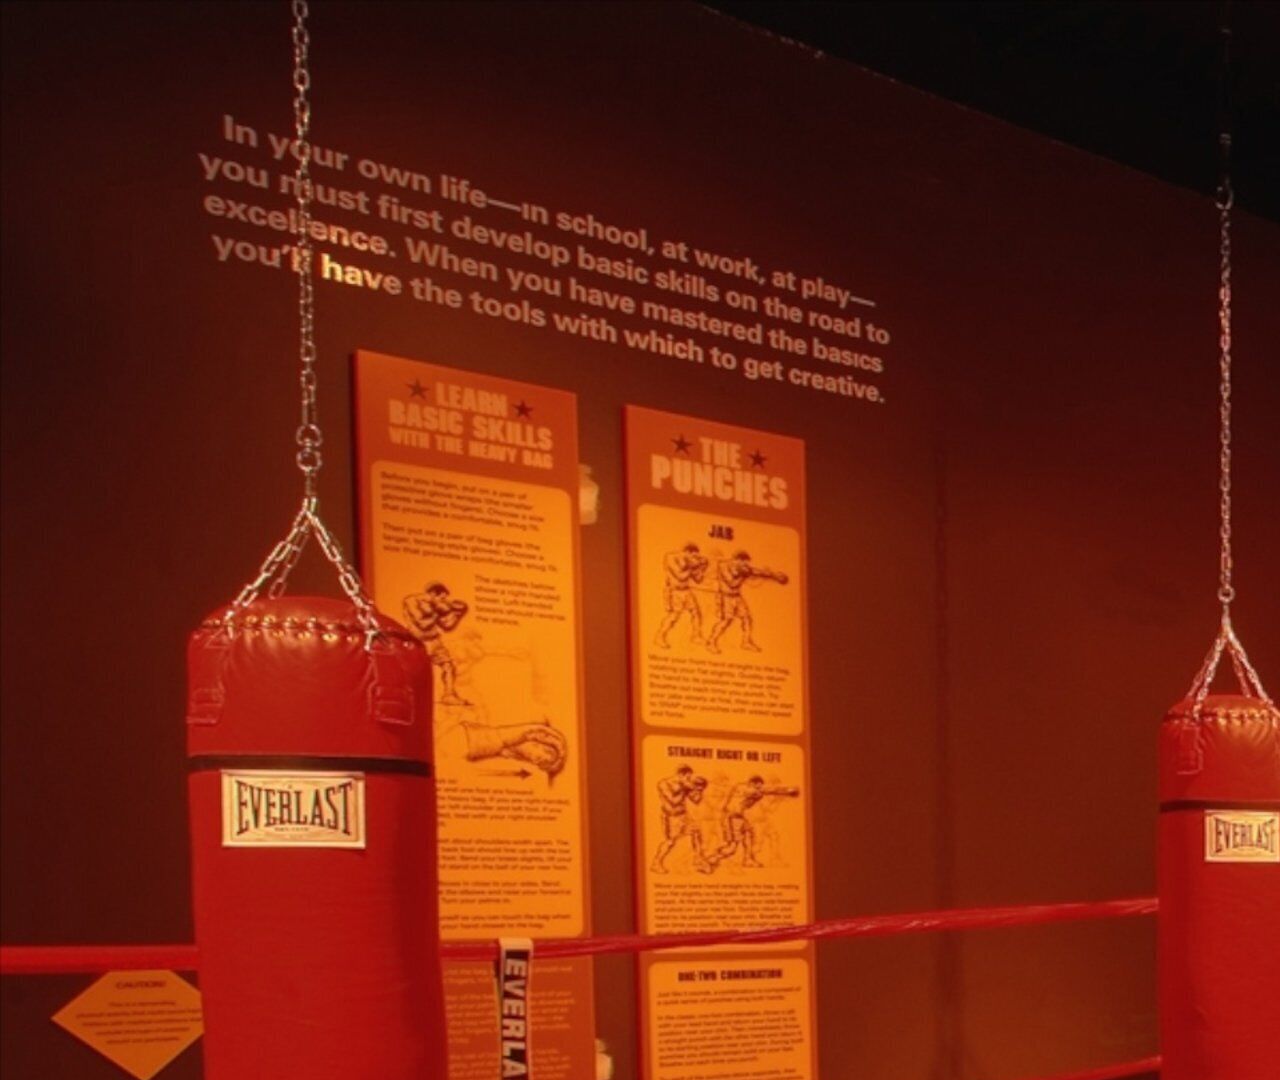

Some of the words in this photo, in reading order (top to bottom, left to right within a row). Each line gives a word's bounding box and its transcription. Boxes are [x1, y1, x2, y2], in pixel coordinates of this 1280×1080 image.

[224, 114, 257, 148] In
[268, 136, 349, 172] your
[358, 159, 431, 194] own
[556, 212, 655, 256] school,
[662, 241, 688, 263] at
[694, 249, 766, 285] work,
[772, 271, 796, 291] at
[199, 153, 268, 189] you
[377, 195, 443, 234] first
[451, 216, 570, 267] develop
[577, 245, 649, 285] basic
[655, 269, 720, 302] skills
[726, 290, 757, 313] on
[763, 297, 803, 324] the
[809, 311, 861, 338] road
[865, 323, 890, 345] to
[321, 253, 402, 295] have
[410, 278, 462, 308] the
[470, 291, 546, 327] tools
[553, 313, 617, 343] with
[623, 329, 704, 363] which
[710, 346, 737, 370] to
[744, 357, 783, 381] get
[789, 368, 885, 403] creative.
[405, 236, 498, 282] When
[506, 267, 561, 297] you
[569, 277, 635, 314] have
[643, 301, 762, 345] mastered
[767, 329, 807, 355] the
[813, 337, 883, 373] basics
[436, 382, 507, 416] LEARN
[389, 426, 430, 449] WITH
[435, 434, 464, 455] THE
[469, 441, 517, 464] HEAVY
[522, 450, 553, 470] BAG
[390, 401, 464, 435] BASIC
[473, 415, 553, 451] SKILLS
[699, 437, 741, 469] THE
[652, 455, 787, 509] PUNCHES
[708, 525, 734, 541] JAB
[235, 779, 353, 837] EVERLAST
[1214, 816, 1277, 854] EVERLAST
